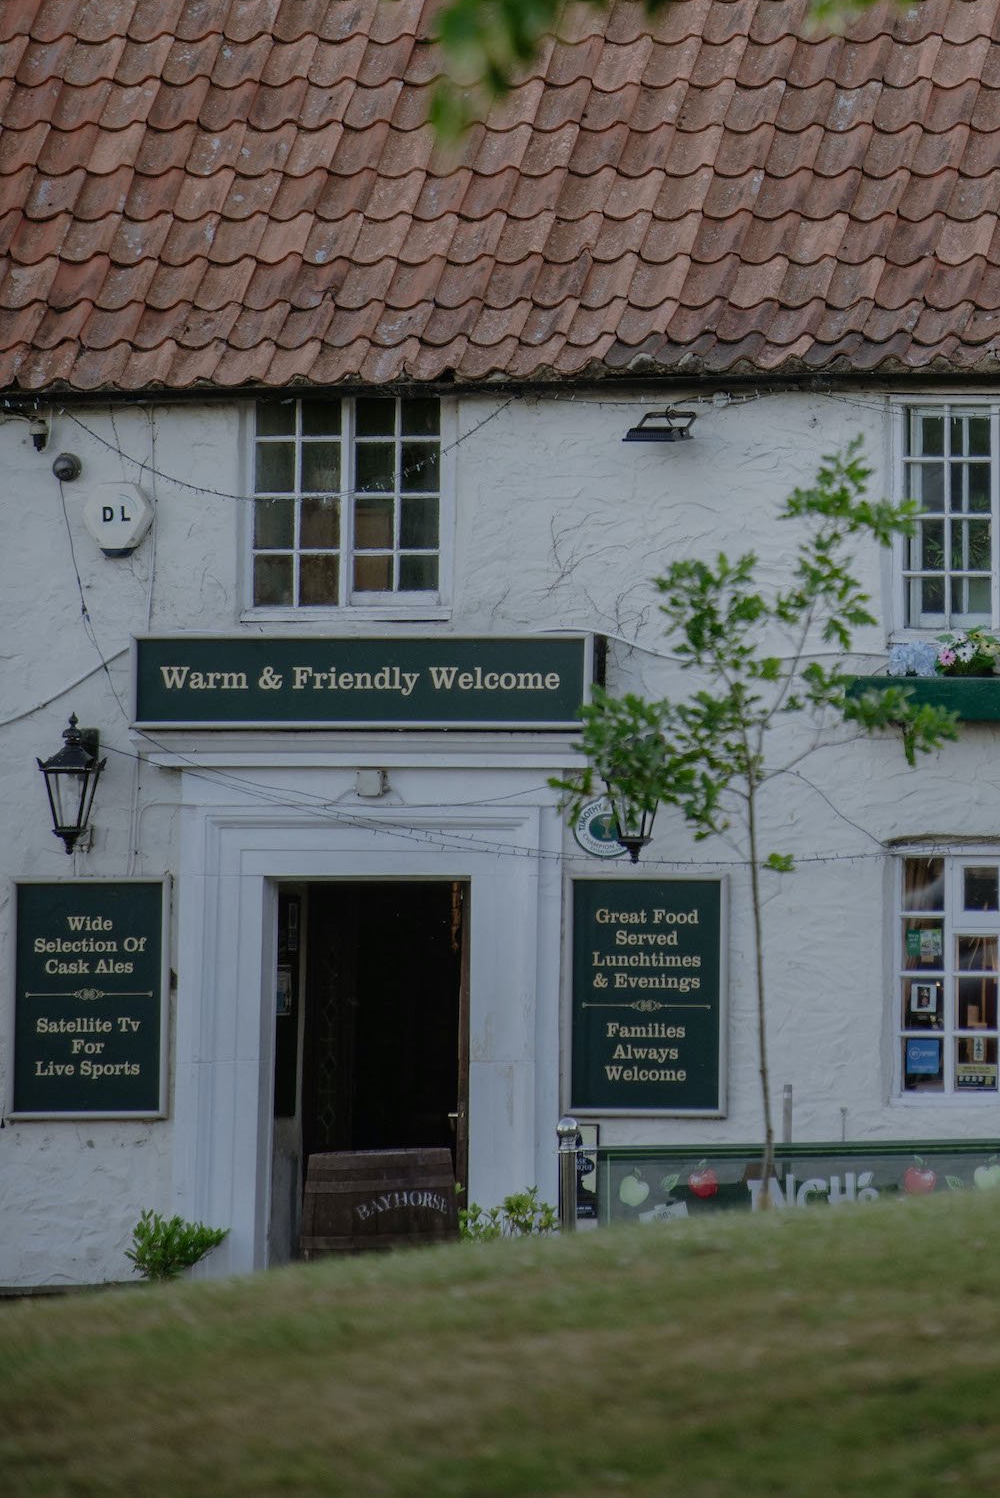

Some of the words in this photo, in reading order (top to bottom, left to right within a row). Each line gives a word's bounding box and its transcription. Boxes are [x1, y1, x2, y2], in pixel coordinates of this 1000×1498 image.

[160, 667, 248, 689] Warm
[259, 666, 282, 690] &
[292, 667, 420, 696] Friendly
[429, 667, 560, 690] Welcome
[578, 803, 602, 832] TIMOTHY
[67, 915, 113, 931] Wide
[595, 908, 647, 924] Great
[652, 908, 700, 924] Food
[34, 937, 118, 953] Selection
[123, 937, 147, 953] Of
[615, 929, 678, 945] Served
[45, 958, 90, 975] Cask
[94, 958, 134, 974] Ales
[592, 951, 702, 968] Lunchtimes
[593, 973, 609, 989] &
[613, 972, 701, 993] Evenings
[36, 1017, 112, 1034] Satellite
[117, 1017, 141, 1033] Tv
[606, 1022, 686, 1039] Families
[72, 1038, 105, 1055] For
[612, 1043, 679, 1063] Always
[35, 1060, 75, 1076] Live
[79, 1060, 141, 1080] Sports
[605, 1065, 687, 1082] Welcome
